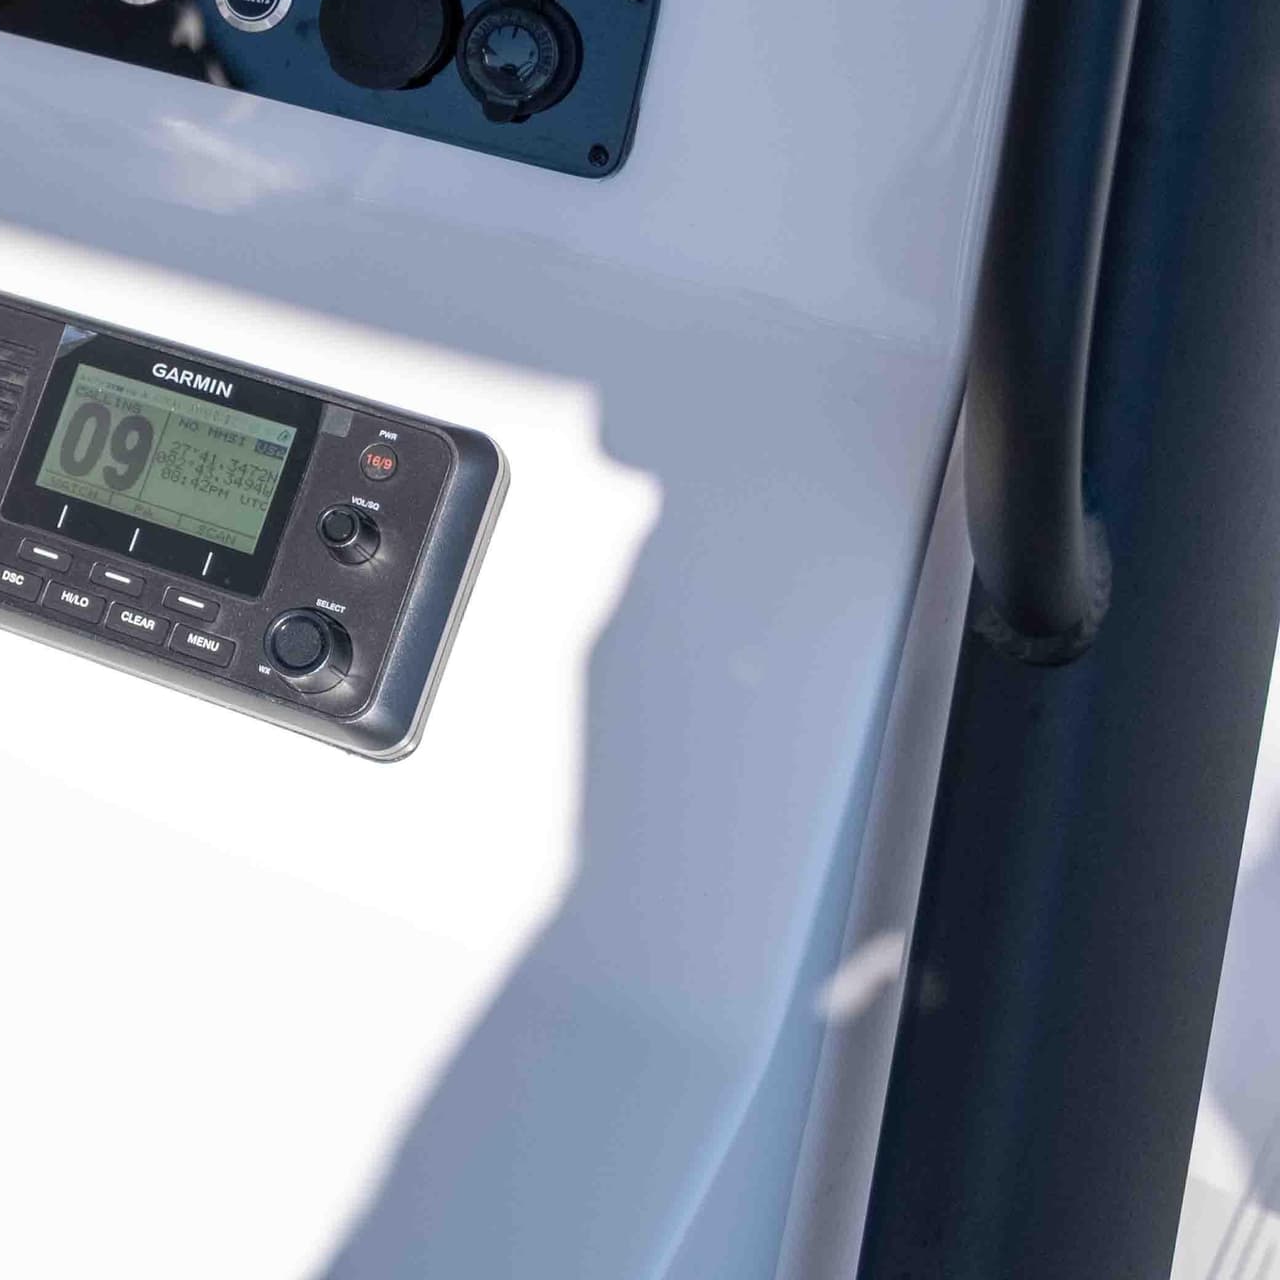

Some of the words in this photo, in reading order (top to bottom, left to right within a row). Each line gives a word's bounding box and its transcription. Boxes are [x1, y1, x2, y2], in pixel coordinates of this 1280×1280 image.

[151, 362, 233, 399] GARMIN
[178, 417, 200, 433] NO
[207, 426, 247, 447] MMSI
[378, 429, 398, 441] PWR
[59, 402, 155, 492] 09
[366, 453, 394, 471] 16/9
[239, 495, 269, 512] UTC
[351, 495, 380, 512] VOL/SQ
[198, 524, 238, 547] SCAN
[1, 569, 25, 587] DSC
[61, 590, 90, 608] HI/LO
[316, 598, 347, 613] SELECT
[120, 610, 156, 631] CLEAR
[187, 632, 221, 653] MENU
